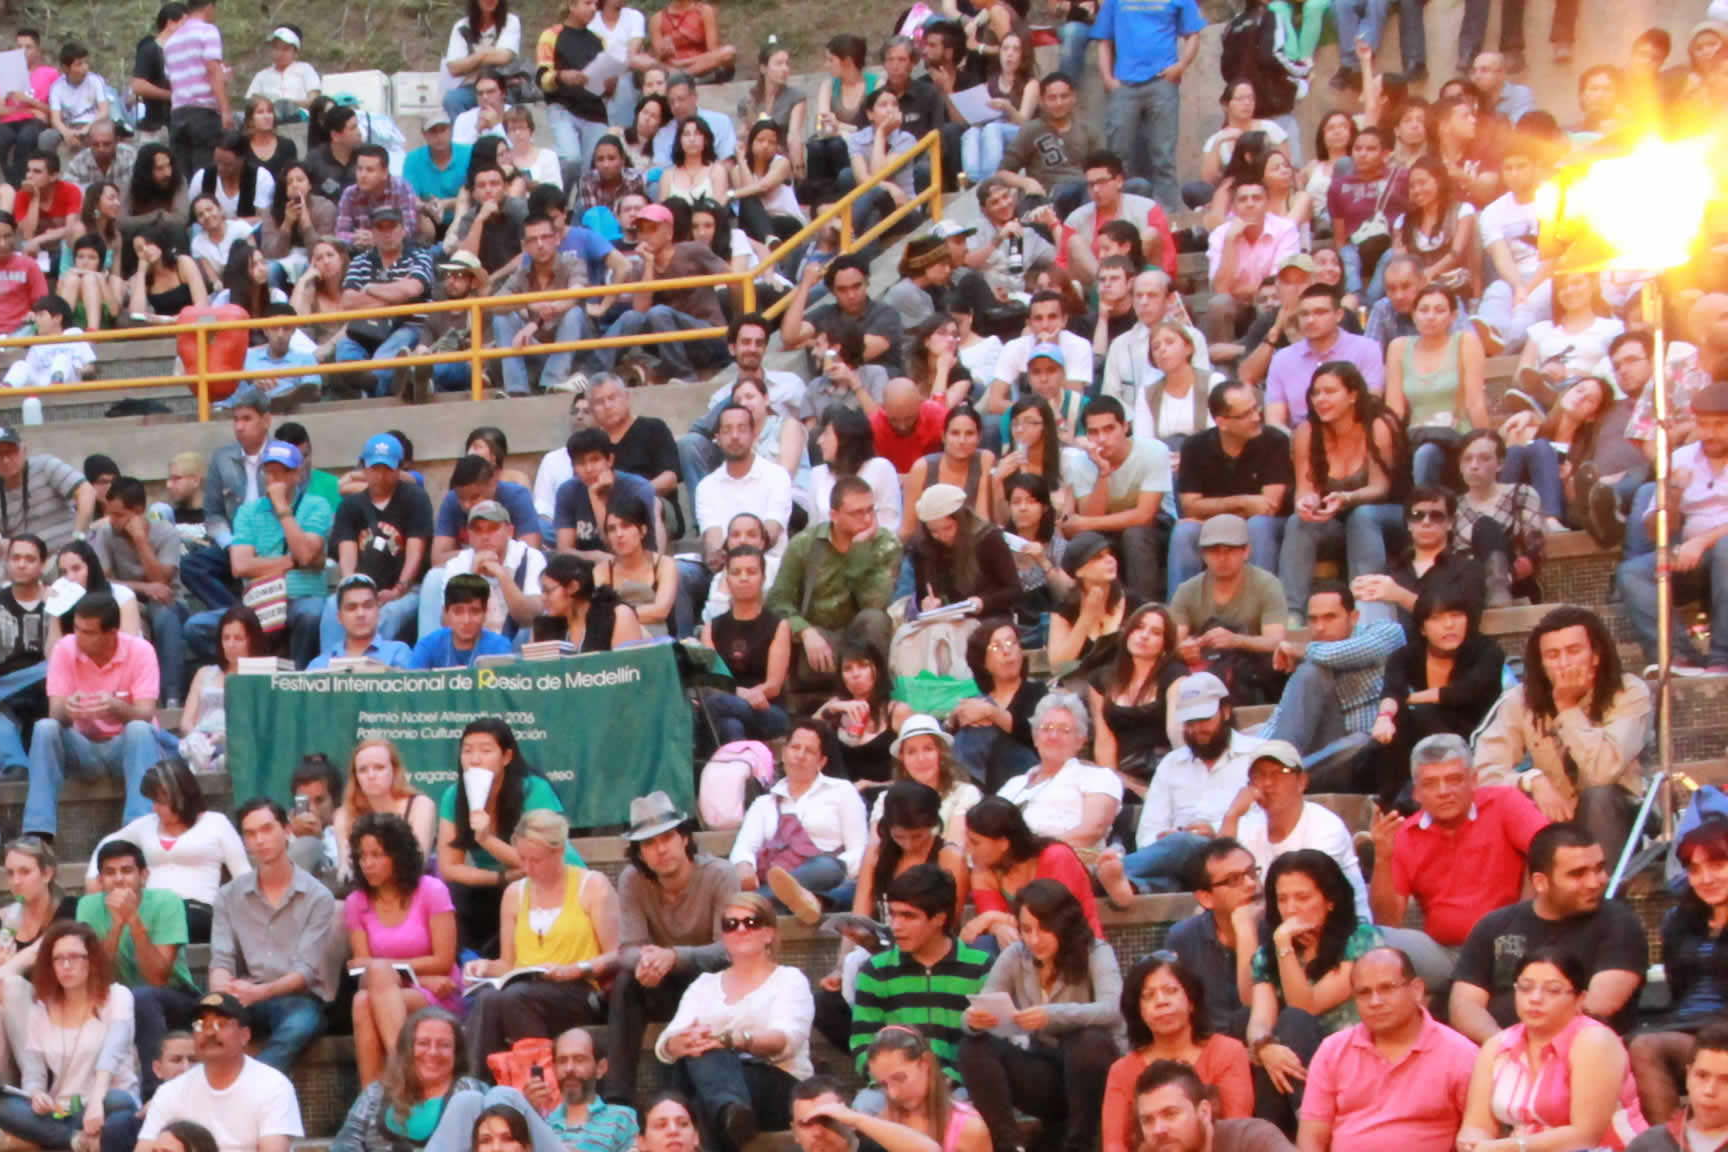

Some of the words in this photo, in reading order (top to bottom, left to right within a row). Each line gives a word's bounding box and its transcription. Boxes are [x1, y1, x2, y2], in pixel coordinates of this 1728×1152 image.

[271, 675, 330, 692] Festival
[333, 675, 445, 693] Internacional
[449, 673, 473, 690] de
[536, 673, 562, 691] de
[565, 665, 641, 689] Medellín
[358, 711, 399, 723] Premio
[401, 711, 438, 723] Nobel
[505, 711, 536, 724] 2006
[356, 727, 418, 740] Patrimonio
[420, 727, 463, 740] Cultura
